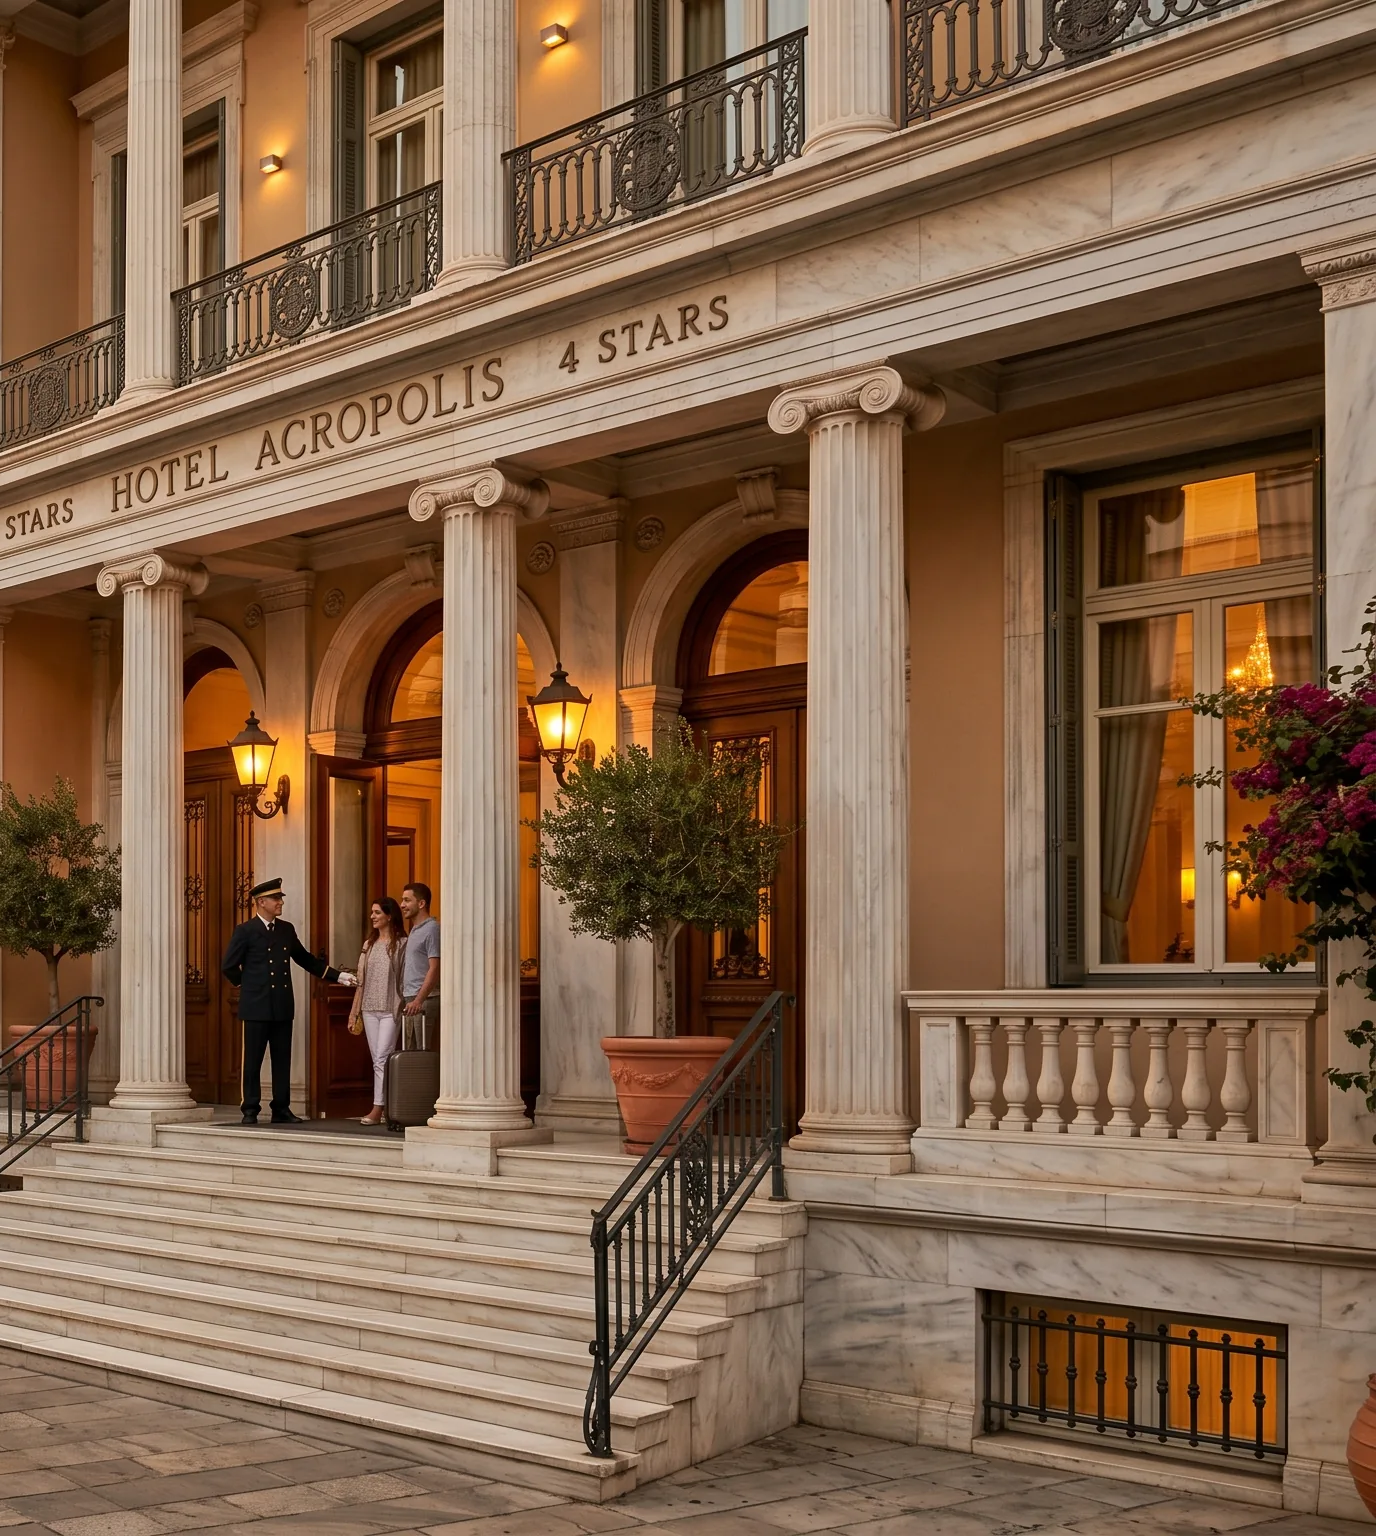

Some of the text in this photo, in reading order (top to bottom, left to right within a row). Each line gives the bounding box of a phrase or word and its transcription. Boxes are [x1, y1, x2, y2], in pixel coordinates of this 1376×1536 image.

[5, 498, 74, 540] STARS
[111, 444, 229, 512] HOTEL
[255, 357, 505, 471] ACROPOLIS
[558, 341, 580, 373] 4
[598, 295, 729, 363] STARS
